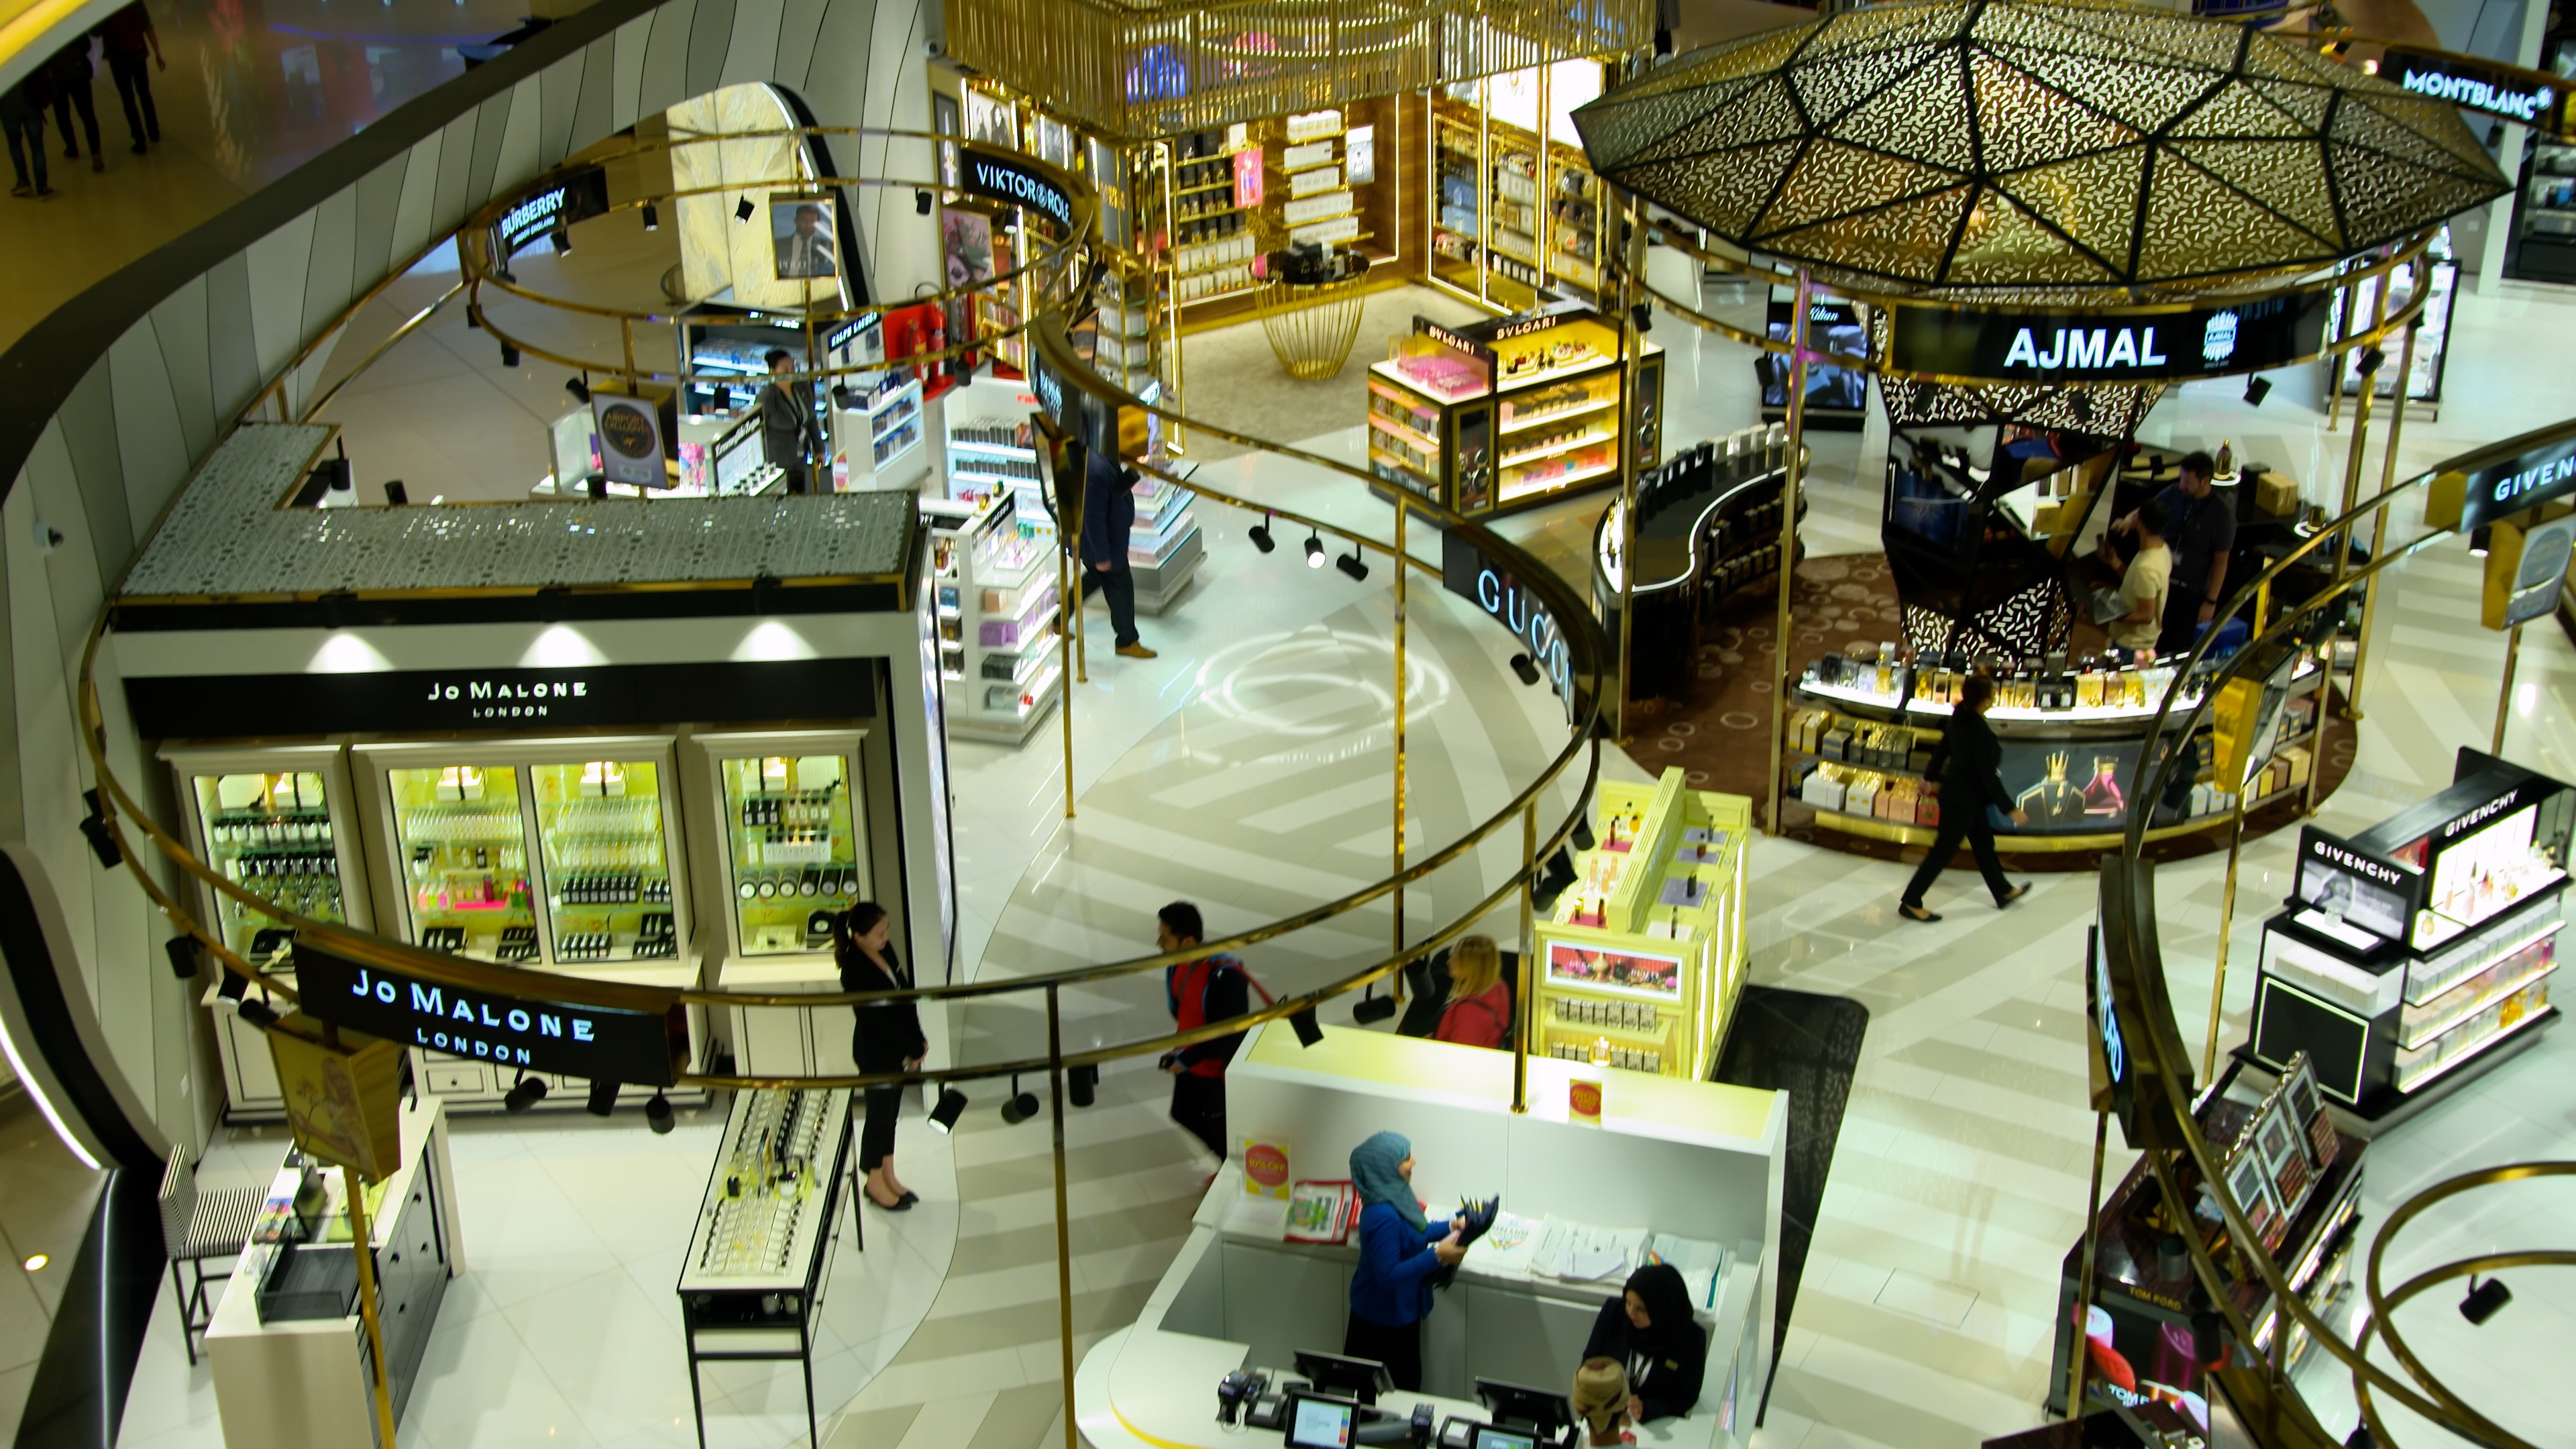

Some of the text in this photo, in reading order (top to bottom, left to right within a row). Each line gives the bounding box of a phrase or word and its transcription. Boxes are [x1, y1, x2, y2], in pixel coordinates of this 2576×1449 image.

[2404, 68, 2536, 121] MONTBLANC
[501, 186, 566, 240] BURBERRY
[1429, 325, 1474, 356] BVLGARI
[1497, 315, 1557, 340] BVLGARI
[2004, 327, 2167, 370] AJMAL
[1478, 569, 1570, 702] GUCCI
[470, 681, 587, 700] MALONE
[472, 705, 548, 718] LONDON
[2445, 789, 2518, 837] GIVENCHY
[2314, 841, 2402, 885] GIVENCHY
[410, 981, 595, 1042] MALONE
[417, 1027, 531, 1065] LONDON
[2129, 1286, 2182, 1312] TOM FORD
[2108, 1383, 2139, 1406] TOM
